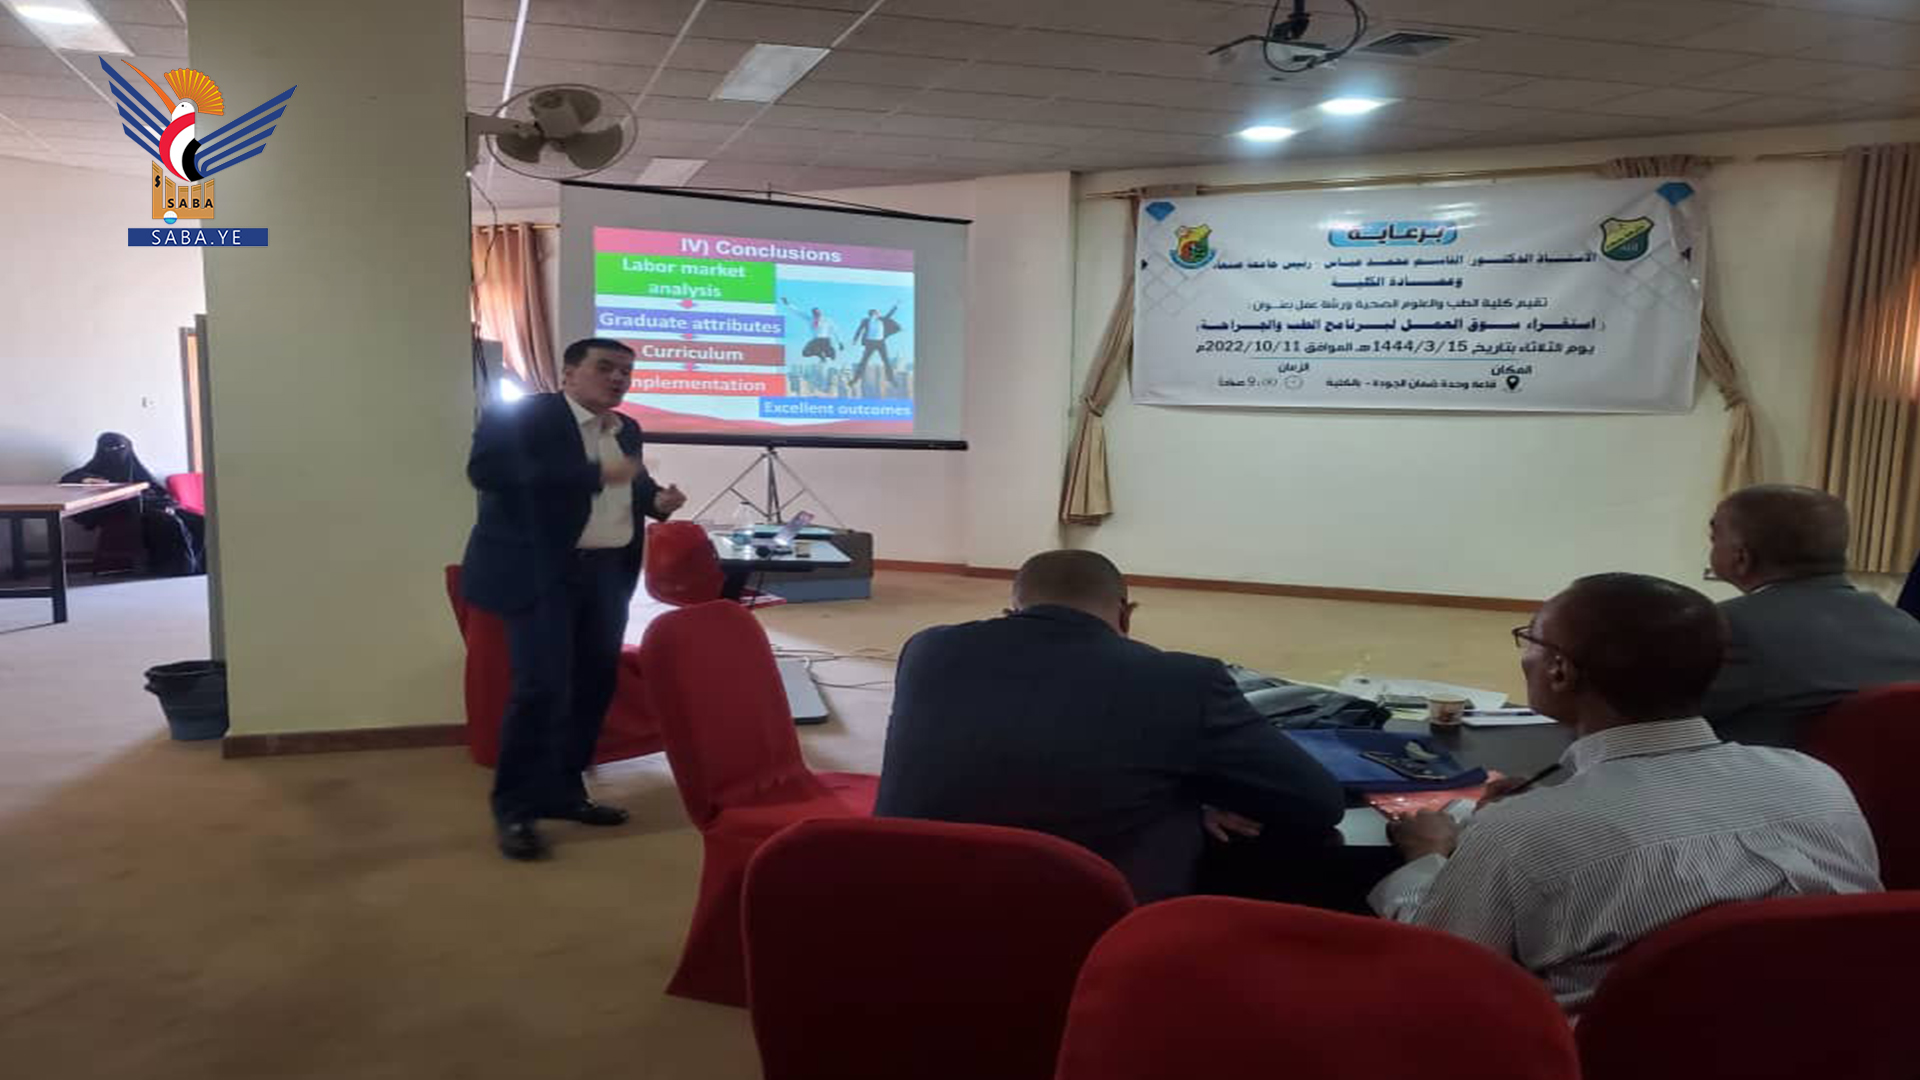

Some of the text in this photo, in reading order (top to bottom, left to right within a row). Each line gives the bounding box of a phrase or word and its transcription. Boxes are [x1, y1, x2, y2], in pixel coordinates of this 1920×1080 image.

[1347, 223, 1443, 243] برعاية
[681, 237, 843, 263] IV) Conclusions
[621, 257, 747, 279] Labor market
[648, 281, 722, 299] analysis
[599, 312, 781, 334] Graduate attributes
[641, 344, 744, 362] Curriculum
[1564, 343, 1596, 355] يوم
[1491, 364, 1533, 376] المكان
[764, 400, 912, 418] Excellent outcomes
